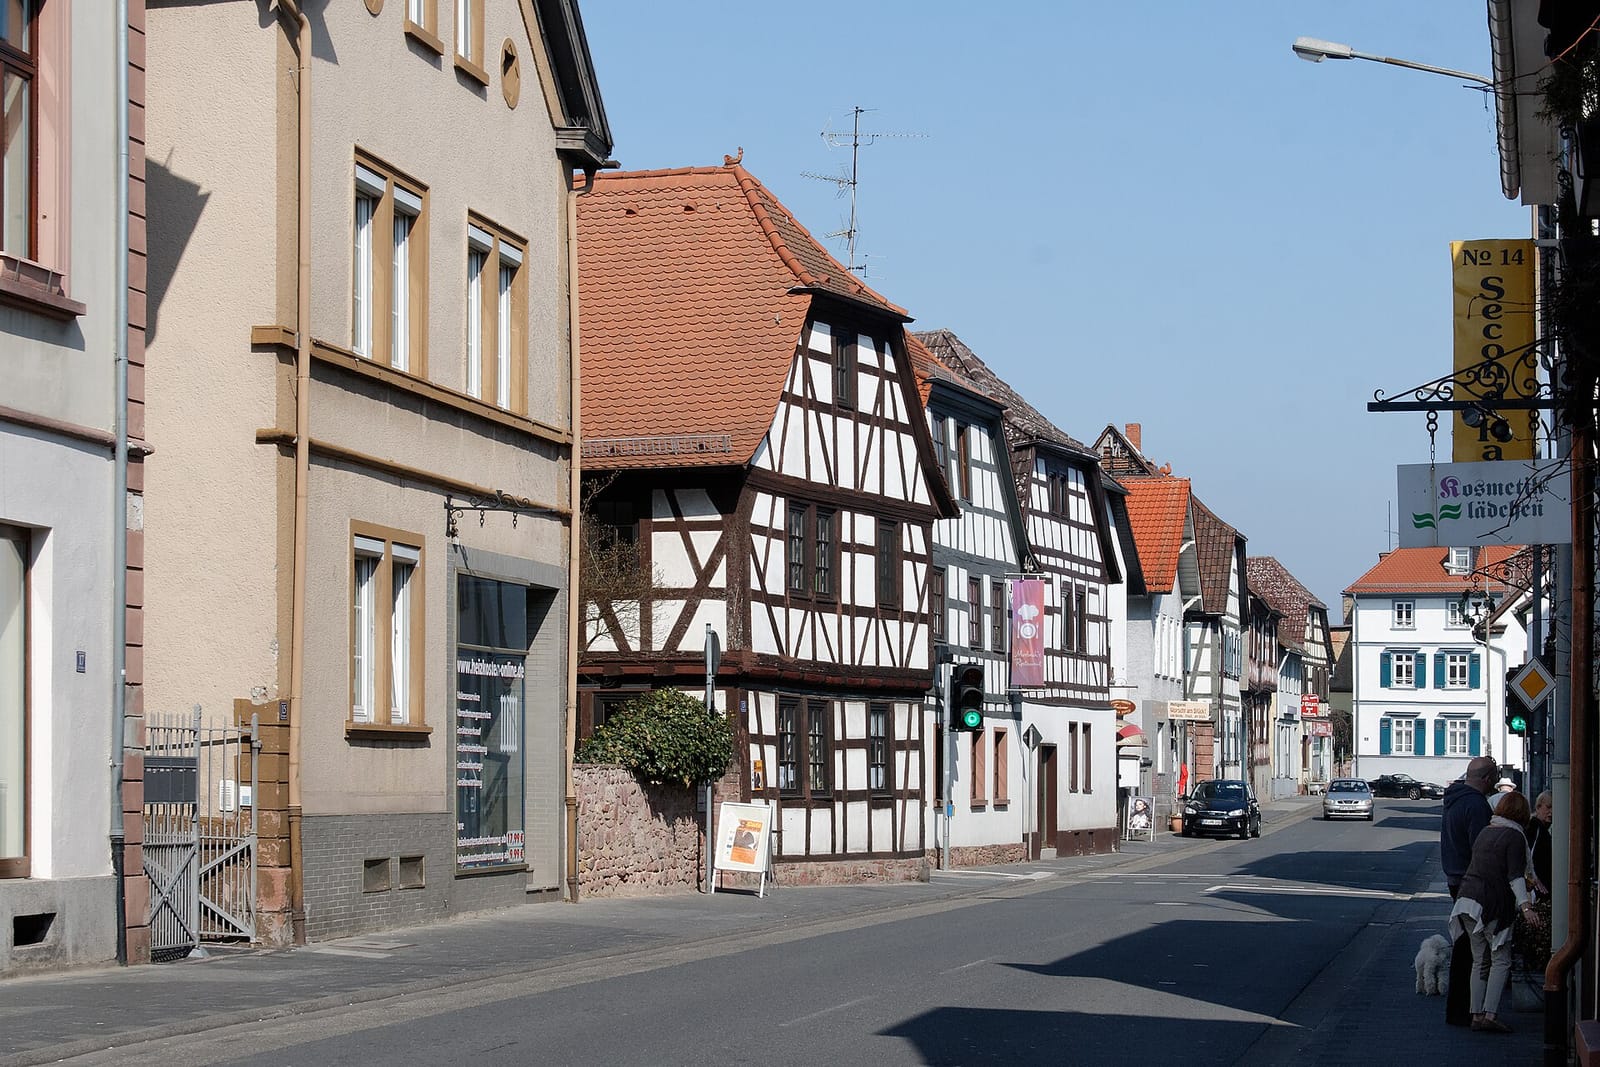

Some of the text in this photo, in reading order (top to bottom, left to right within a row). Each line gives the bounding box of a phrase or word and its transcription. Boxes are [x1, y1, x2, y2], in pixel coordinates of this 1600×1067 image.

[1500, 248, 1525, 266] 14
[1440, 476, 1545, 499] Kosmetik
[1467, 500, 1545, 522] lädchen
